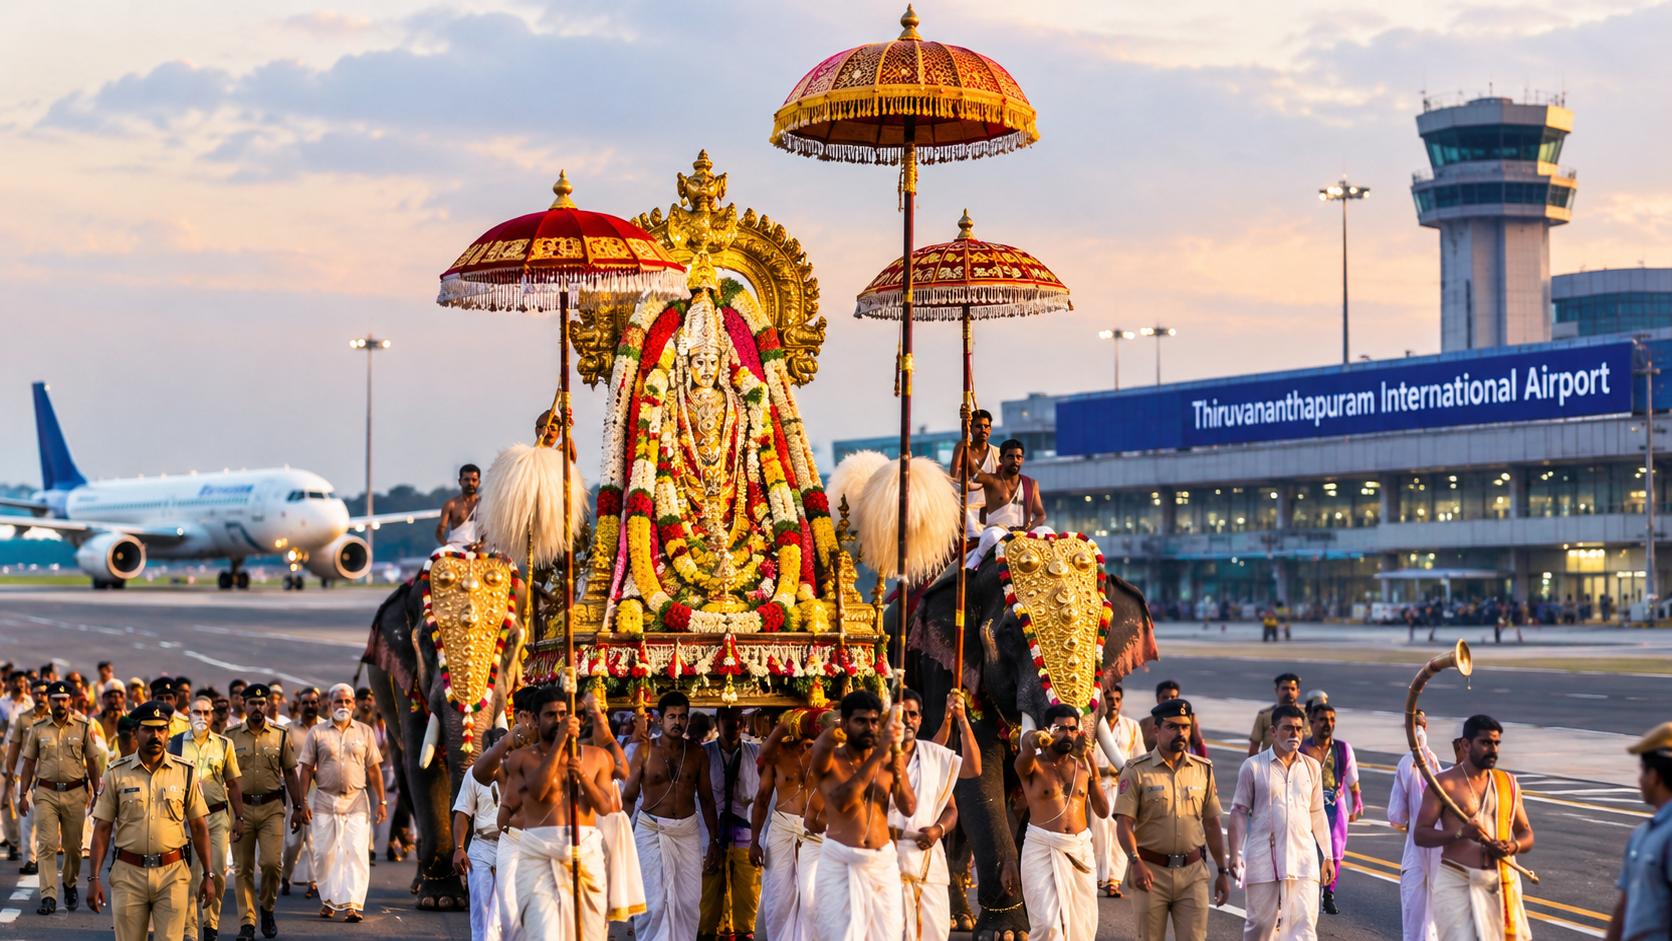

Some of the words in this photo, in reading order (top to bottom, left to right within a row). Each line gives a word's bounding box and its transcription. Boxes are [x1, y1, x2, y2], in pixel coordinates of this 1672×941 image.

[1192, 389, 1375, 430] Thiruvananthapuram
[1381, 368, 1517, 413] International
[1524, 361, 1611, 407] Airport
